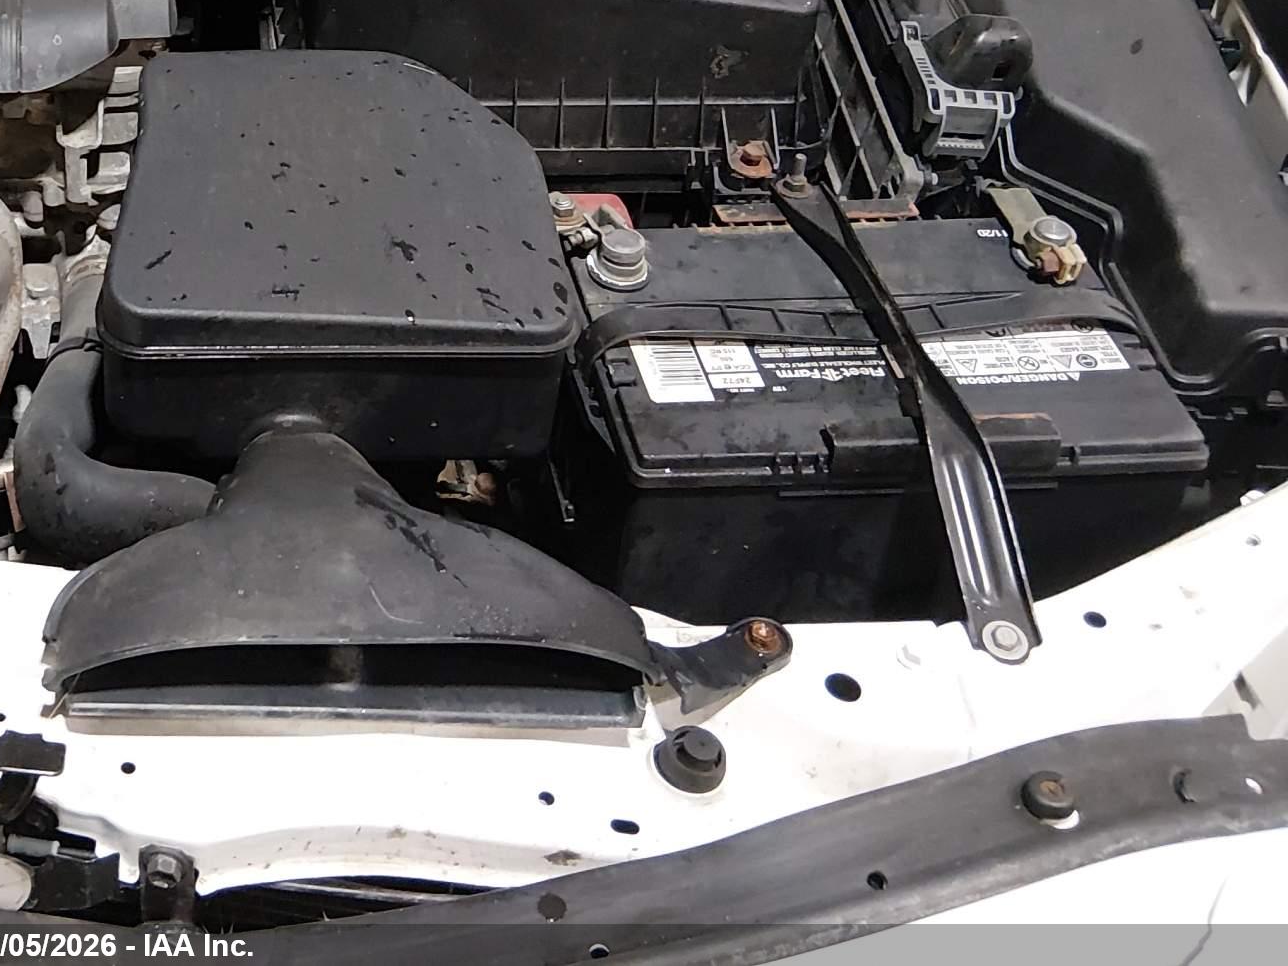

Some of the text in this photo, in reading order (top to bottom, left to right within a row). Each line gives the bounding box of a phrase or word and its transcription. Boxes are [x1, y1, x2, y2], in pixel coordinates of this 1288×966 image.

[977, 229, 1008, 238] 11/20
[776, 366, 885, 378] Fleet Farm
[957, 373, 1068, 385] DANGER/POISON
